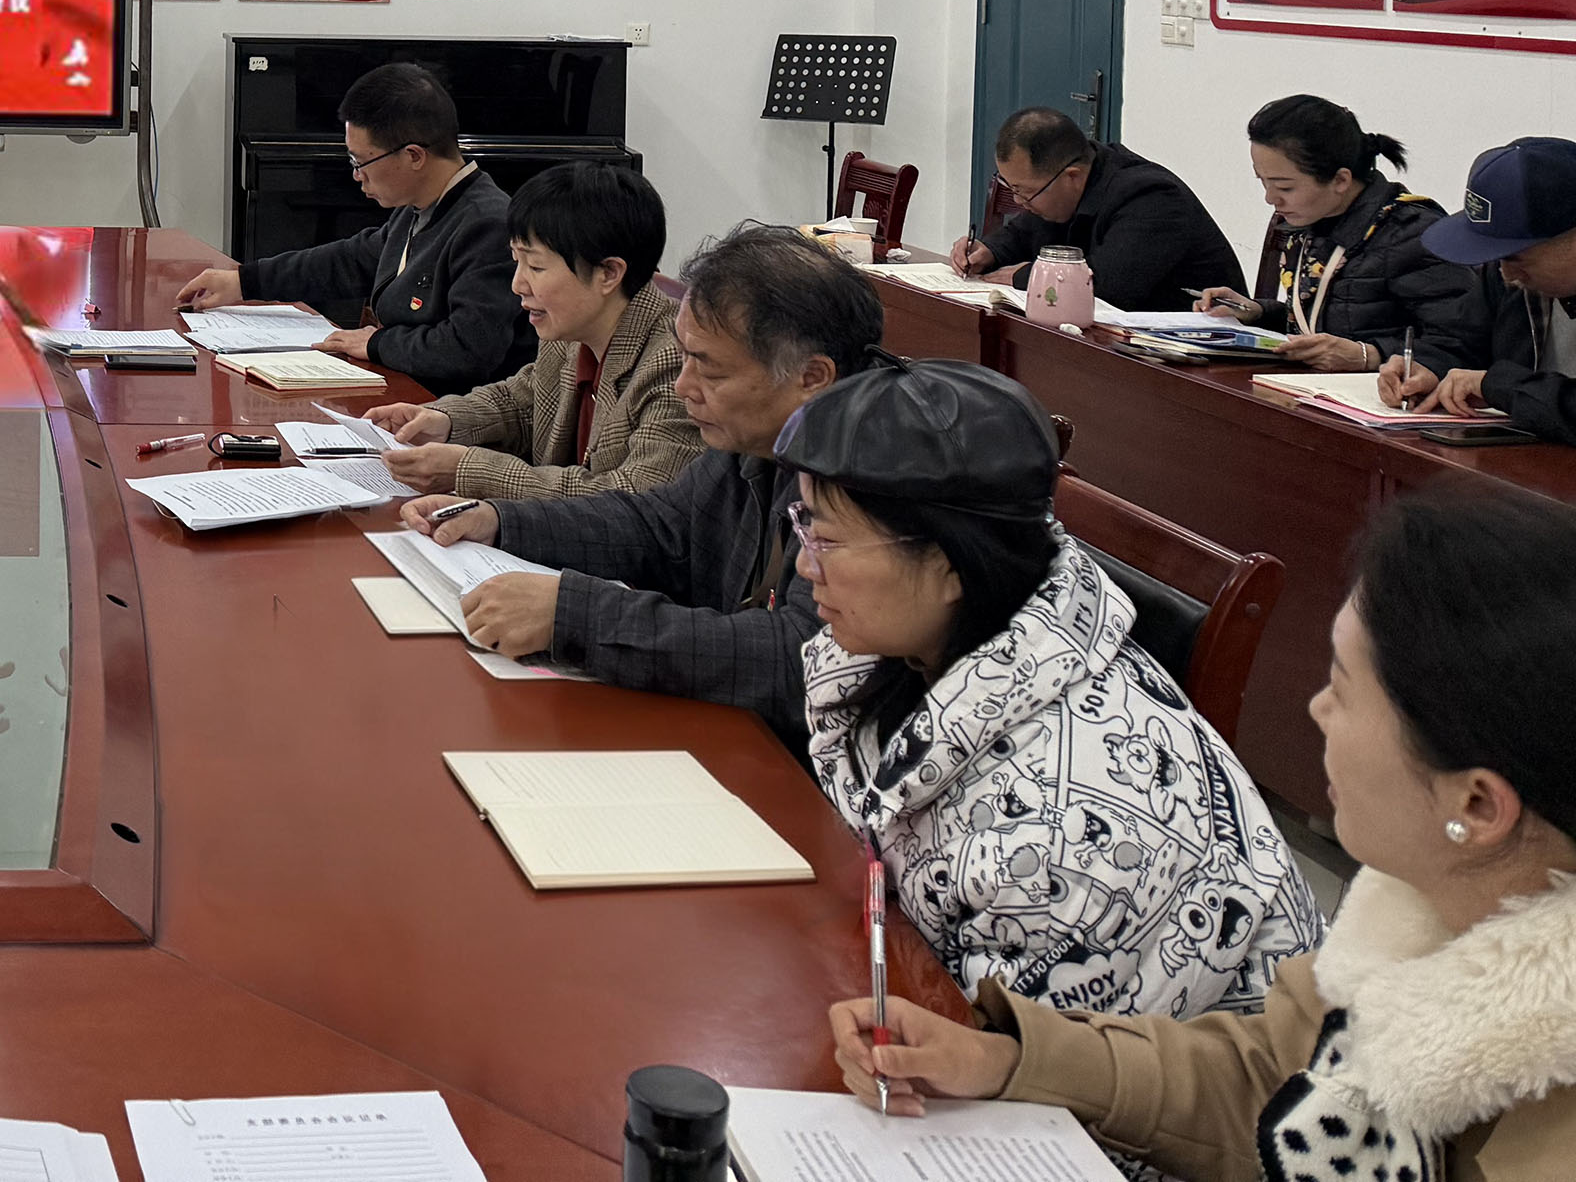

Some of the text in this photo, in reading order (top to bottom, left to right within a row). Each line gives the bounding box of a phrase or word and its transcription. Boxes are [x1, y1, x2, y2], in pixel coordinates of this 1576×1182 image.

[1046, 938, 1076, 965] COOL
[1049, 969, 1117, 1010] ENJOY
[1085, 982, 1130, 1012] USIC
